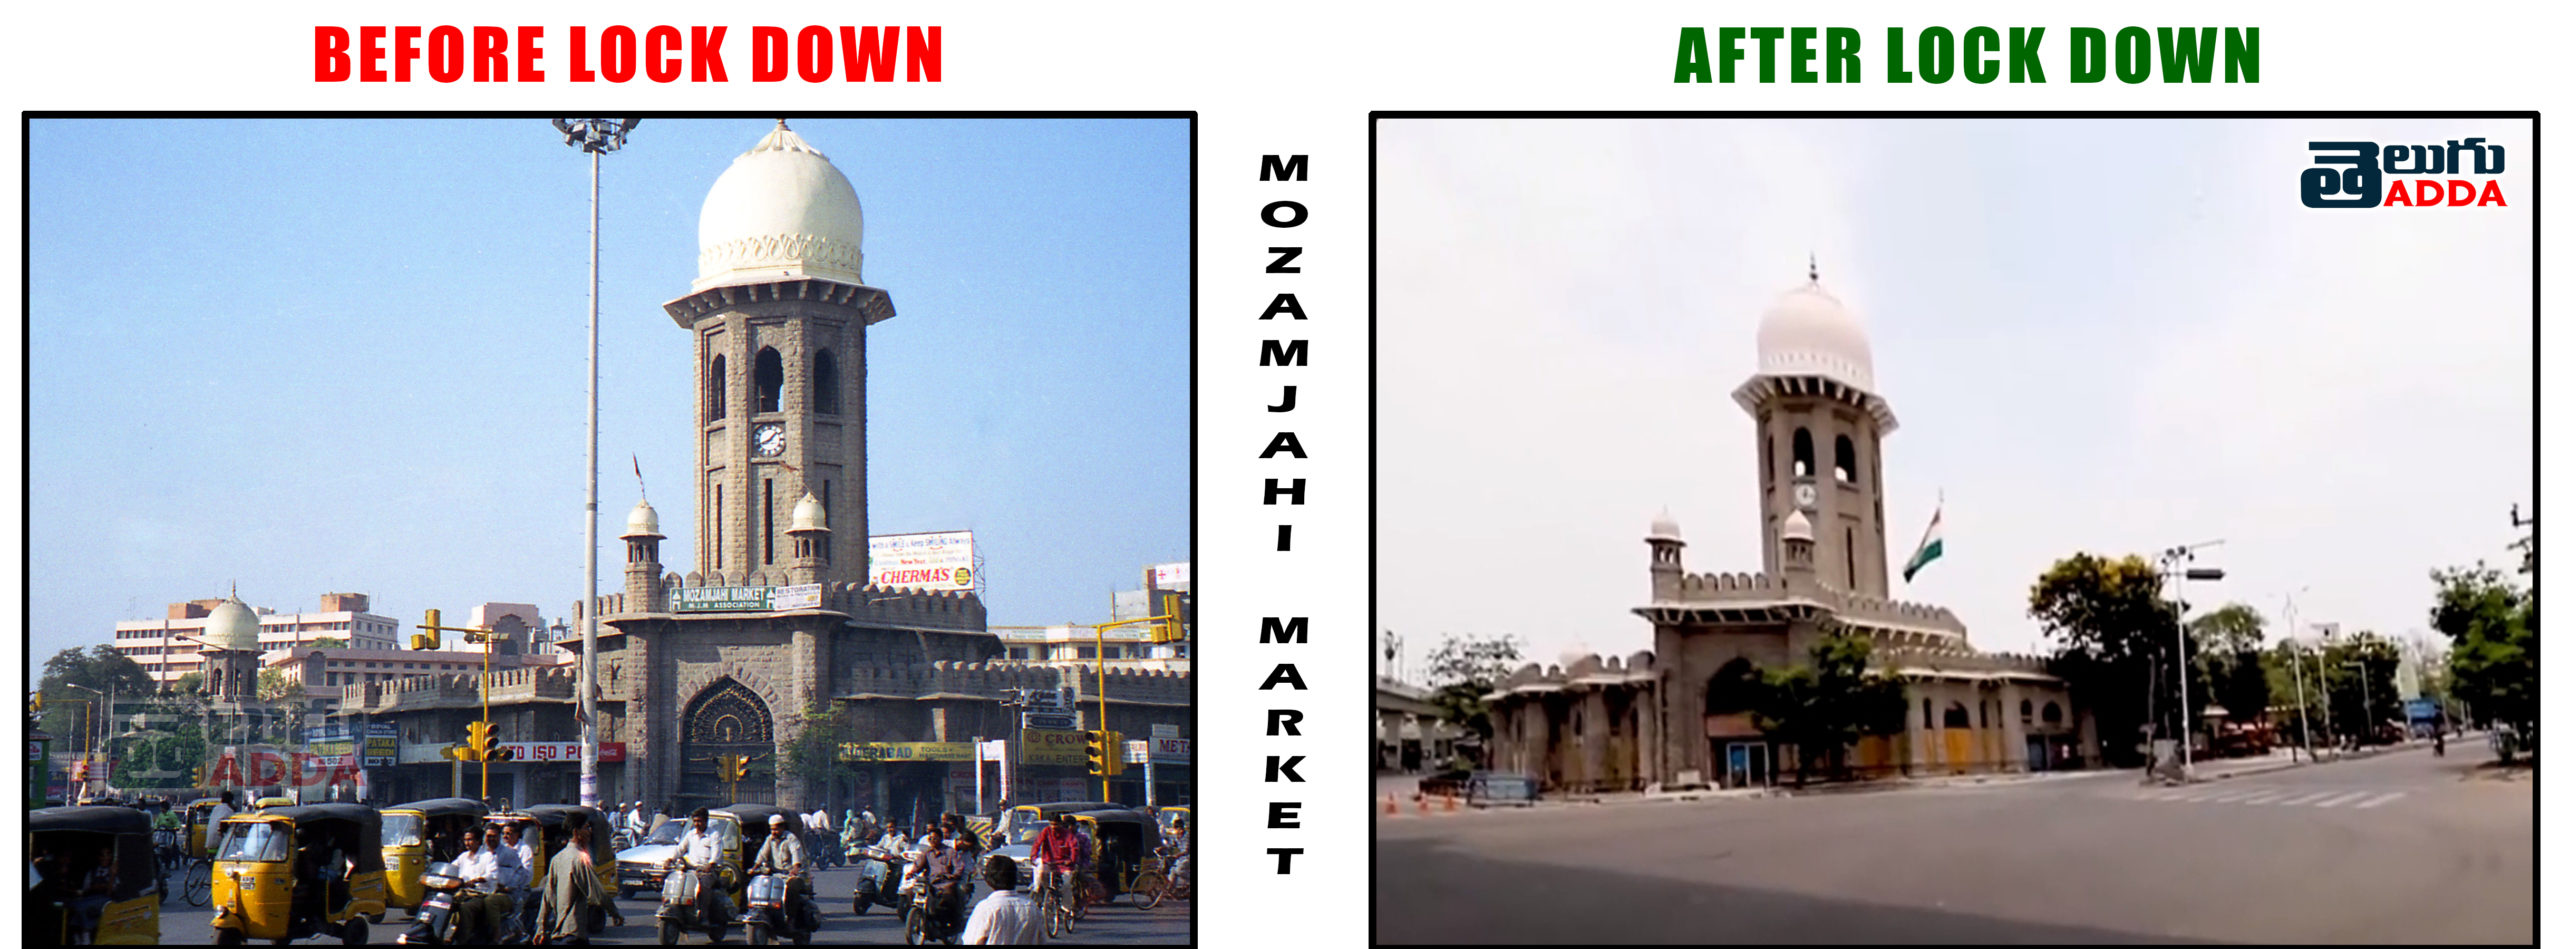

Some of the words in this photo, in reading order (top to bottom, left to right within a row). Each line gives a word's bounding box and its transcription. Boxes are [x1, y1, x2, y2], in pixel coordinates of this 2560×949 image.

[683, 588, 729, 601] MOZAMJAHI
[731, 587, 766, 601] MARKET
[714, 601, 760, 609] ASSOCIATION
[532, 745, 556, 759] ISD
